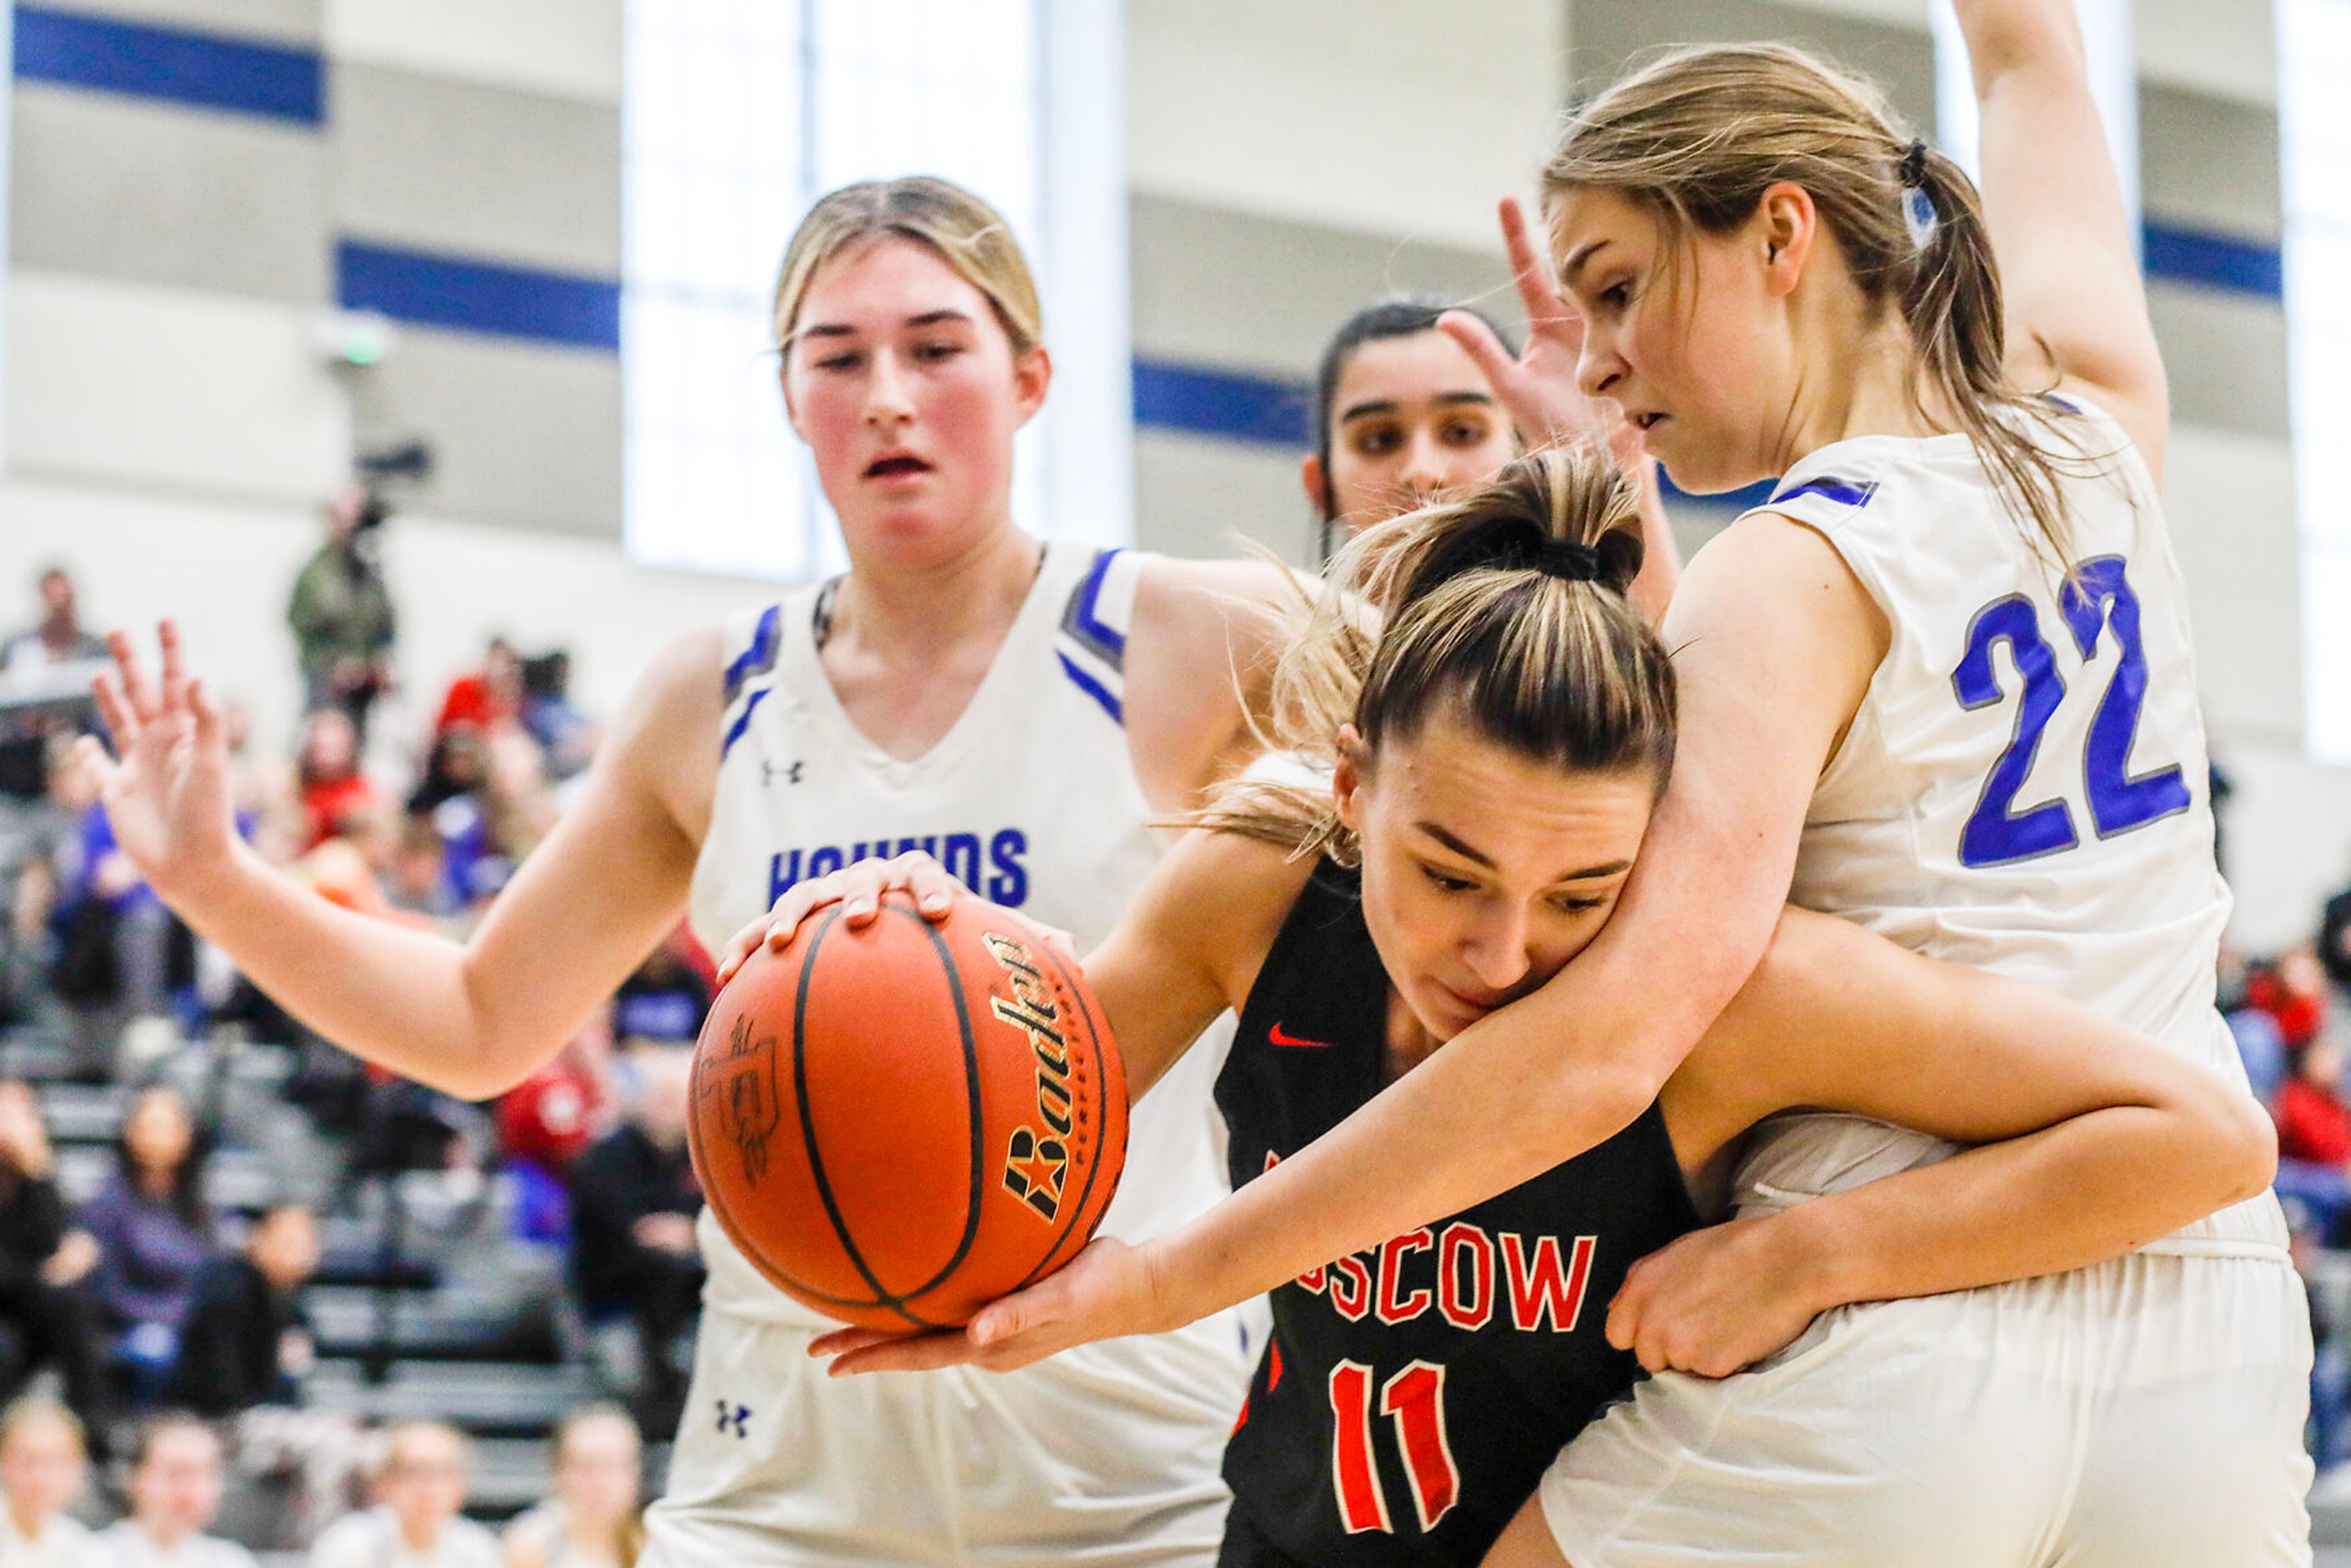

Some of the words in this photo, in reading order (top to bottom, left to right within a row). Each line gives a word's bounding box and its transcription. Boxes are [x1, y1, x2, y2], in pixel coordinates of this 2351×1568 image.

[1951, 553, 2191, 869] 22
[767, 828, 1029, 912] HDS
[982, 931, 1072, 1225] Baden
[1265, 1154, 1597, 1333] SCOW
[1329, 1359, 1460, 1534] 11
